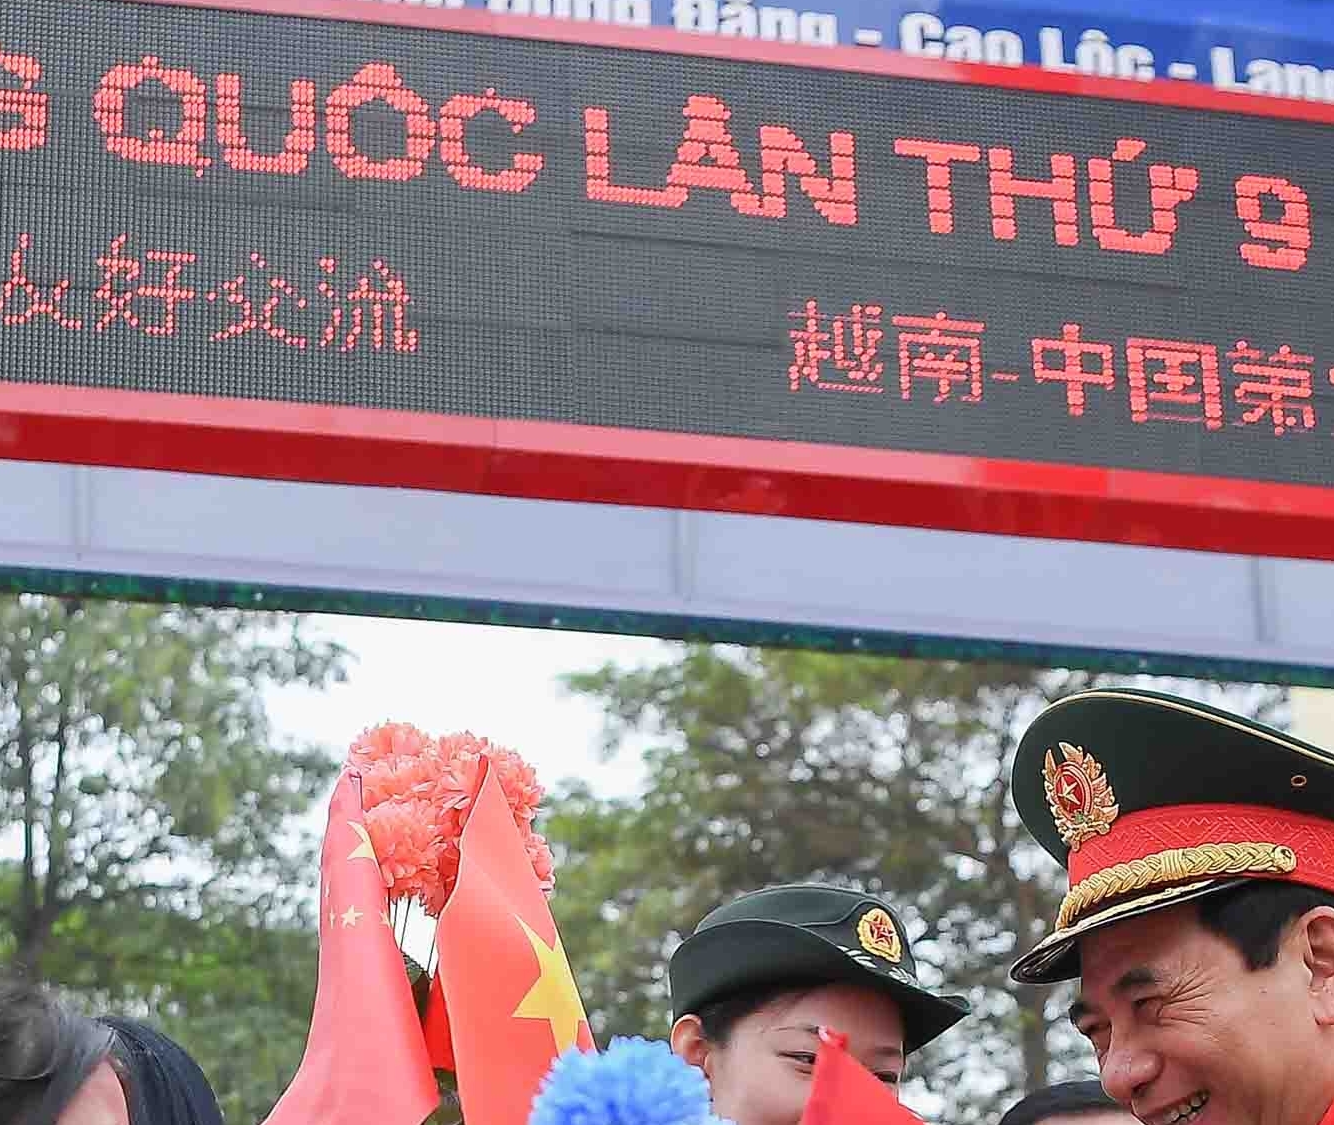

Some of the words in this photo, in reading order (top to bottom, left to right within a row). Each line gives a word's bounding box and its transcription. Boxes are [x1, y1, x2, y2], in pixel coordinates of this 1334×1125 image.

[899, 11, 1025, 66] Cao
[894, 137, 1200, 255] THỨ
[1235, 174, 1312, 271] 9
